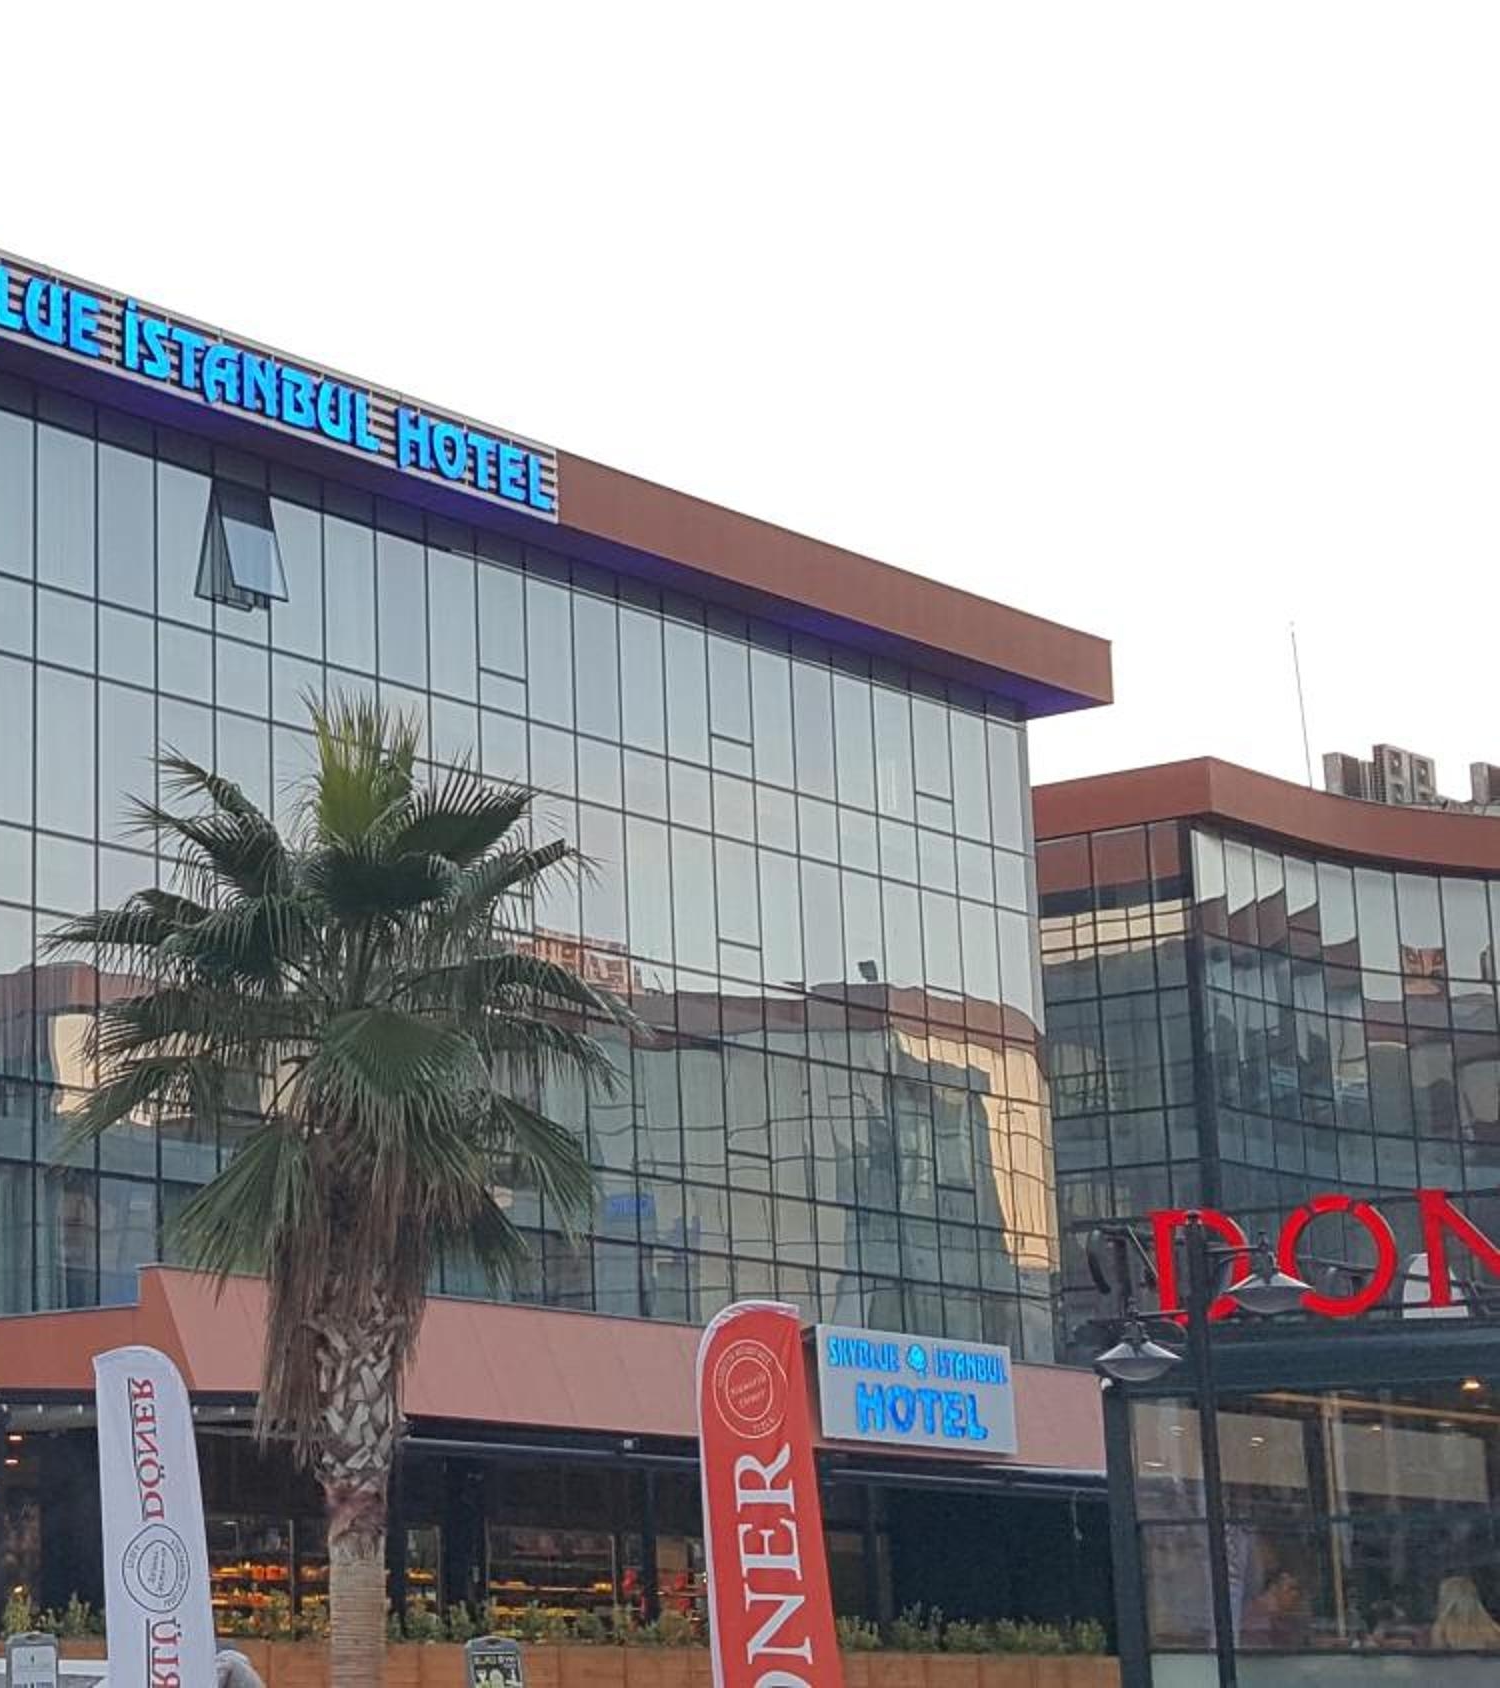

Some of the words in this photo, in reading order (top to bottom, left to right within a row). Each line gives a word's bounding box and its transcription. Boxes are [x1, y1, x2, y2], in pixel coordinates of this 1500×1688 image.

[122, 298, 380, 453] İSTANBUL
[395, 405, 556, 511] HOTEL
[855, 1381, 989, 1441] HOTEL
[733, 1442, 815, 1688] NER
